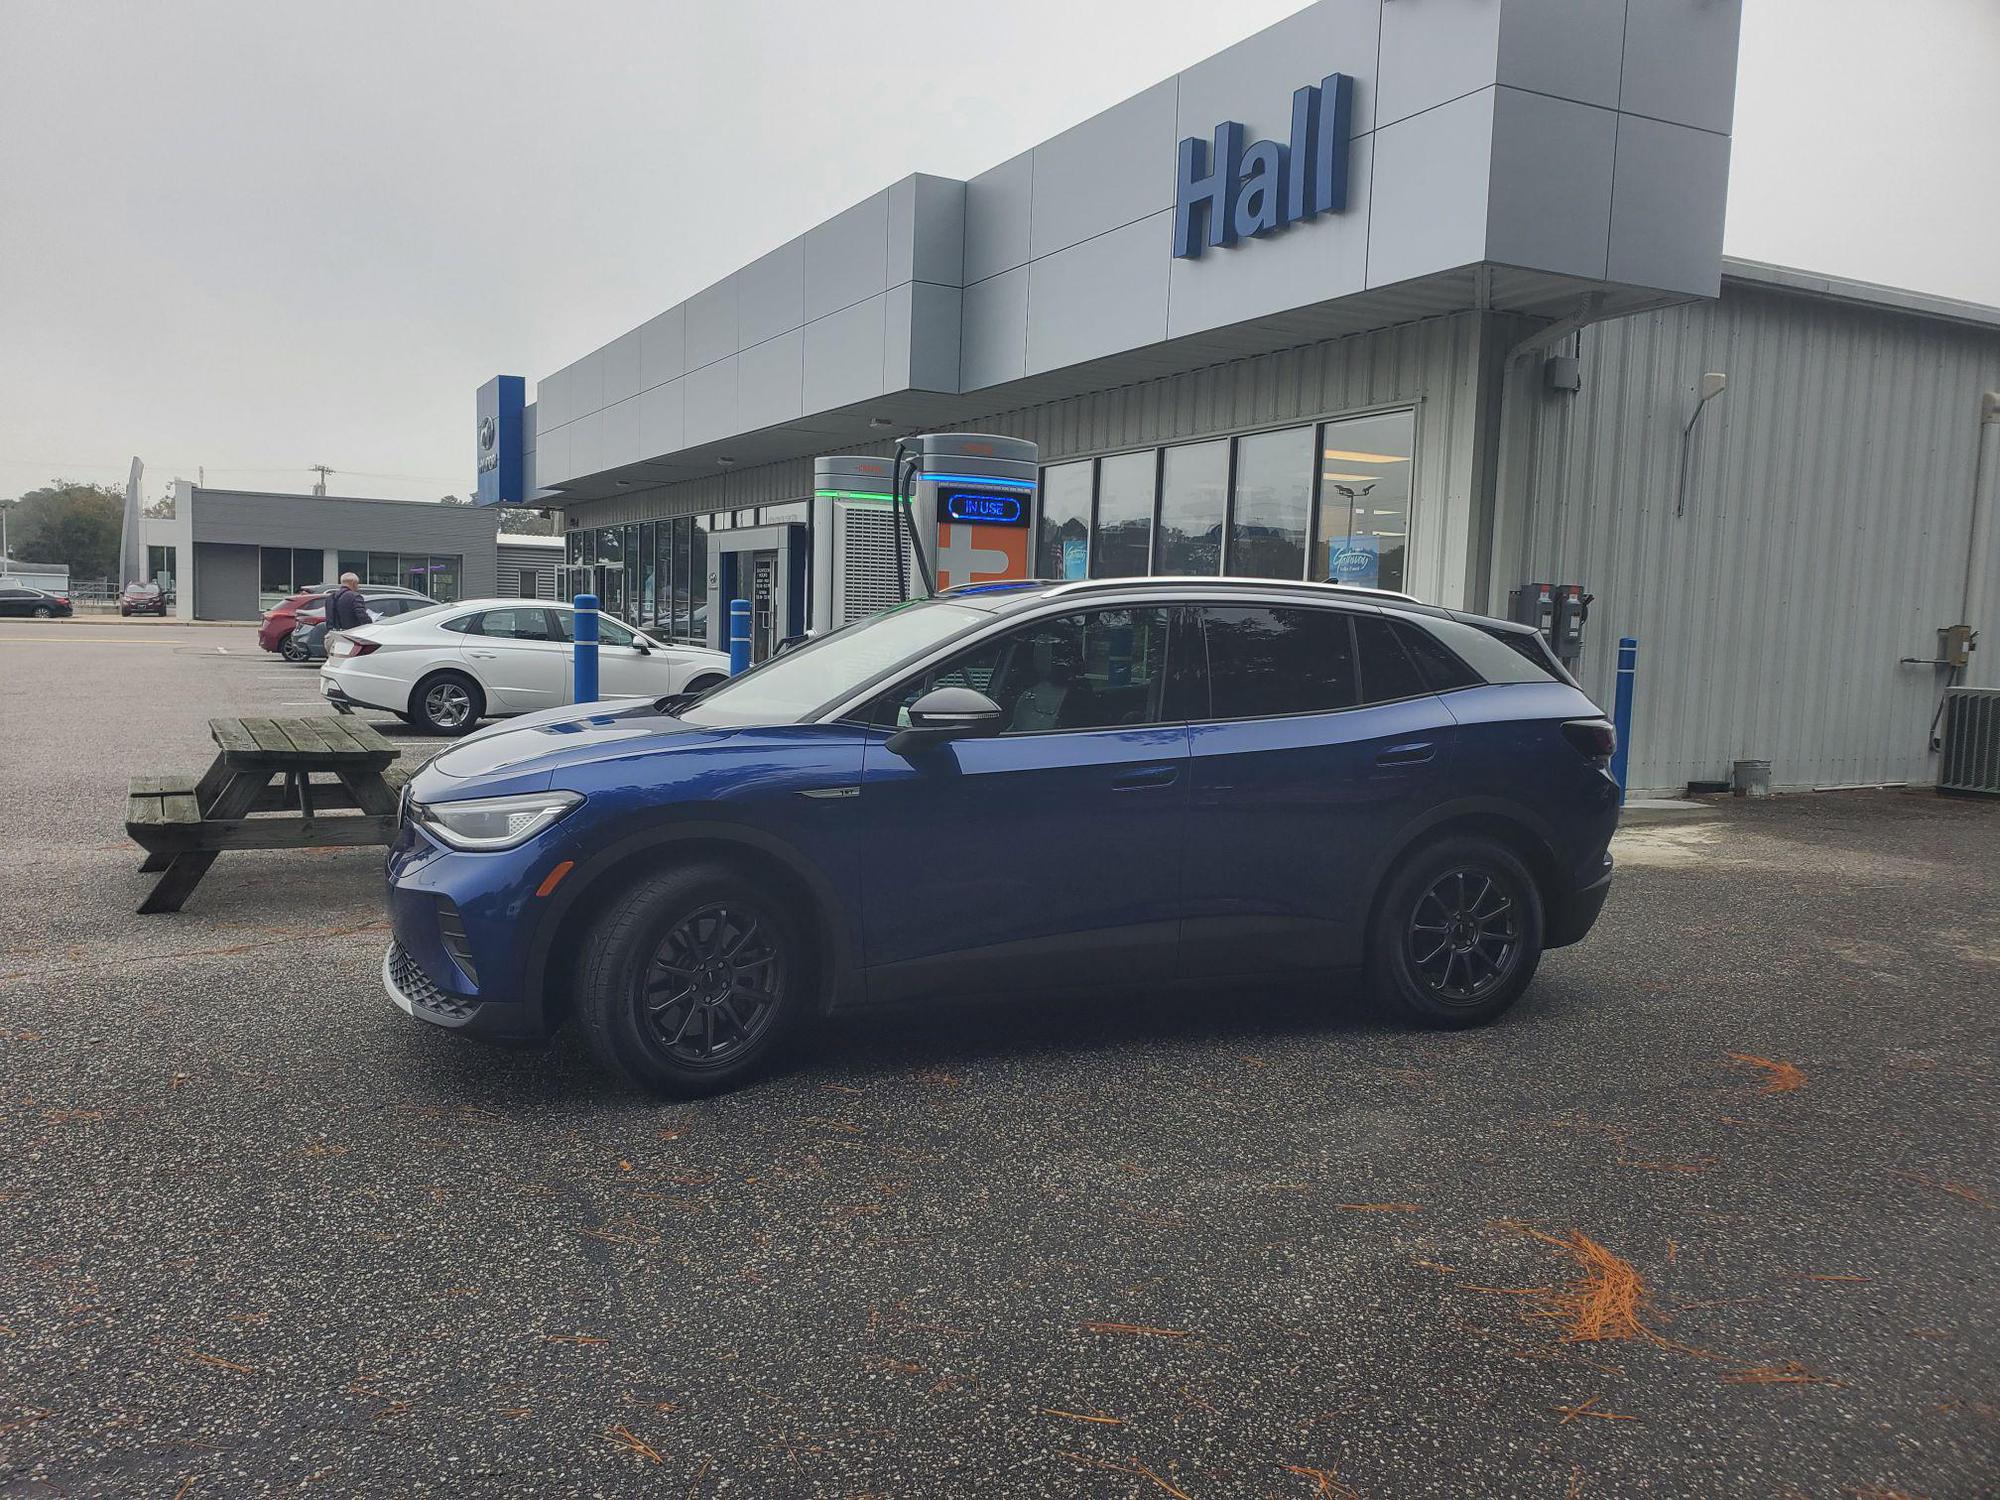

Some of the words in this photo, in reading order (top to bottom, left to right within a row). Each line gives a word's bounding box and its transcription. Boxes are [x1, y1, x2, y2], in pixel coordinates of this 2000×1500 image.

[1173, 72, 1354, 259] Hall
[965, 499, 978, 513] IN
[980, 501, 1004, 515] USE
